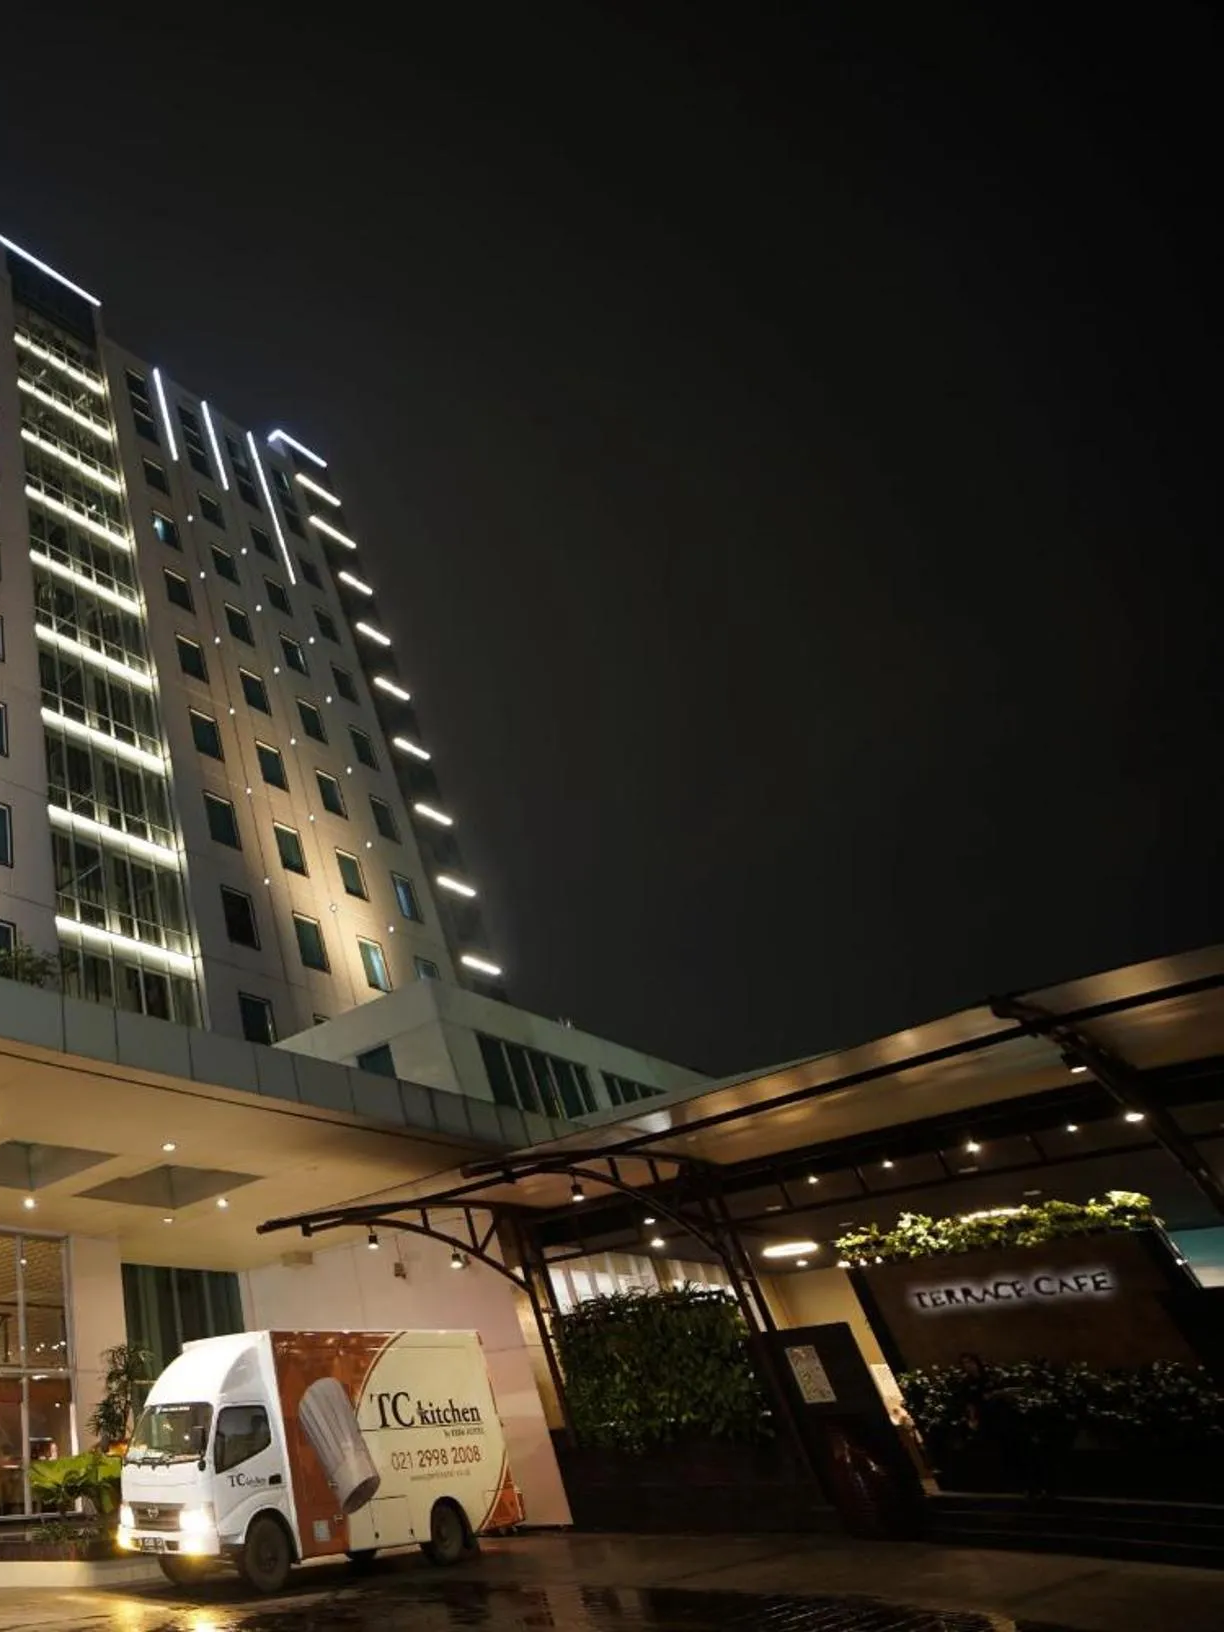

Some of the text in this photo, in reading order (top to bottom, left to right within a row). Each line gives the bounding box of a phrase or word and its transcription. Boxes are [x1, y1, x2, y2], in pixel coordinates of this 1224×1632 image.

[914, 1271, 1114, 1308] TERRACE CAFE
[370, 1391, 481, 1429] TC kitchen
[391, 1444, 481, 1471] 021 2998 2008
